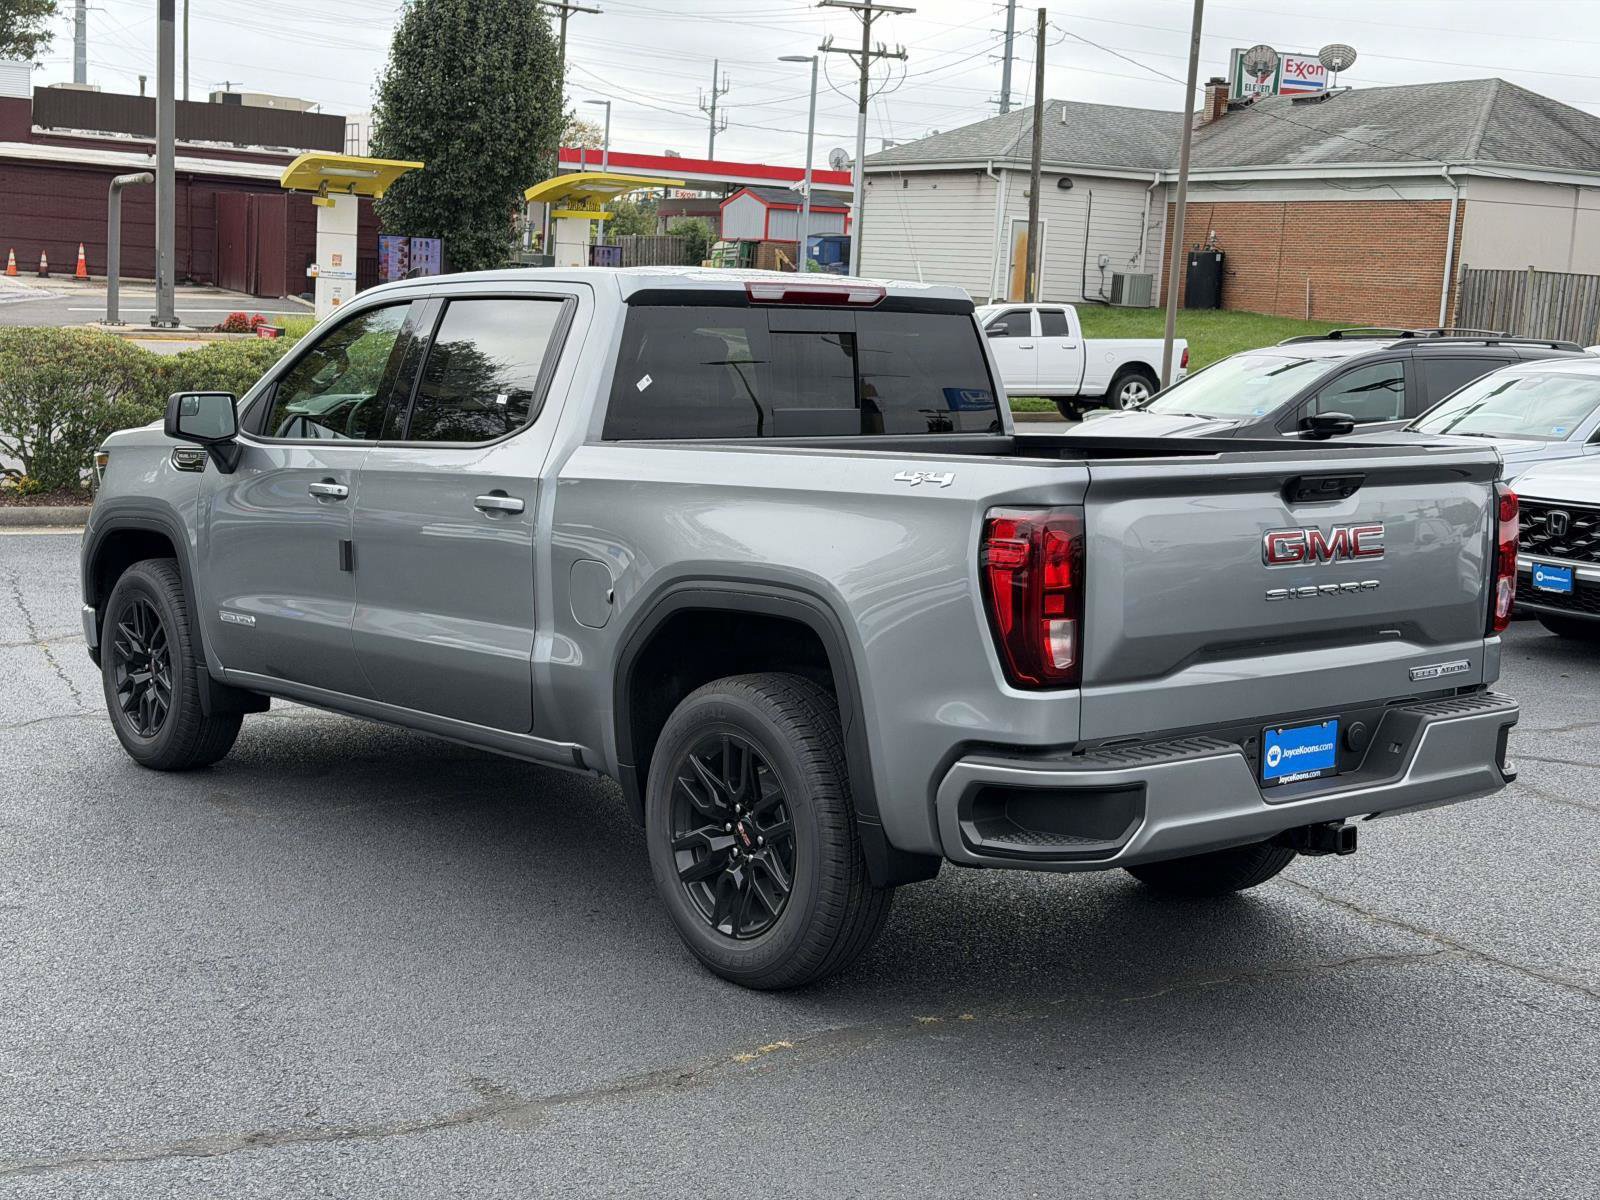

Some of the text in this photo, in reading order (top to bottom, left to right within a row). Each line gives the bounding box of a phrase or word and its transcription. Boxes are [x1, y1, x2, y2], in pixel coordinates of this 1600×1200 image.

[1285, 59, 1324, 79] Exxon
[675, 190, 697, 199] Exxon
[1262, 525, 1385, 569] GMC
[1265, 580, 1380, 601] SIERRA
[1281, 742, 1334, 758] JoyceKoons.com
[1278, 770, 1321, 785] JoyceKoons.com
